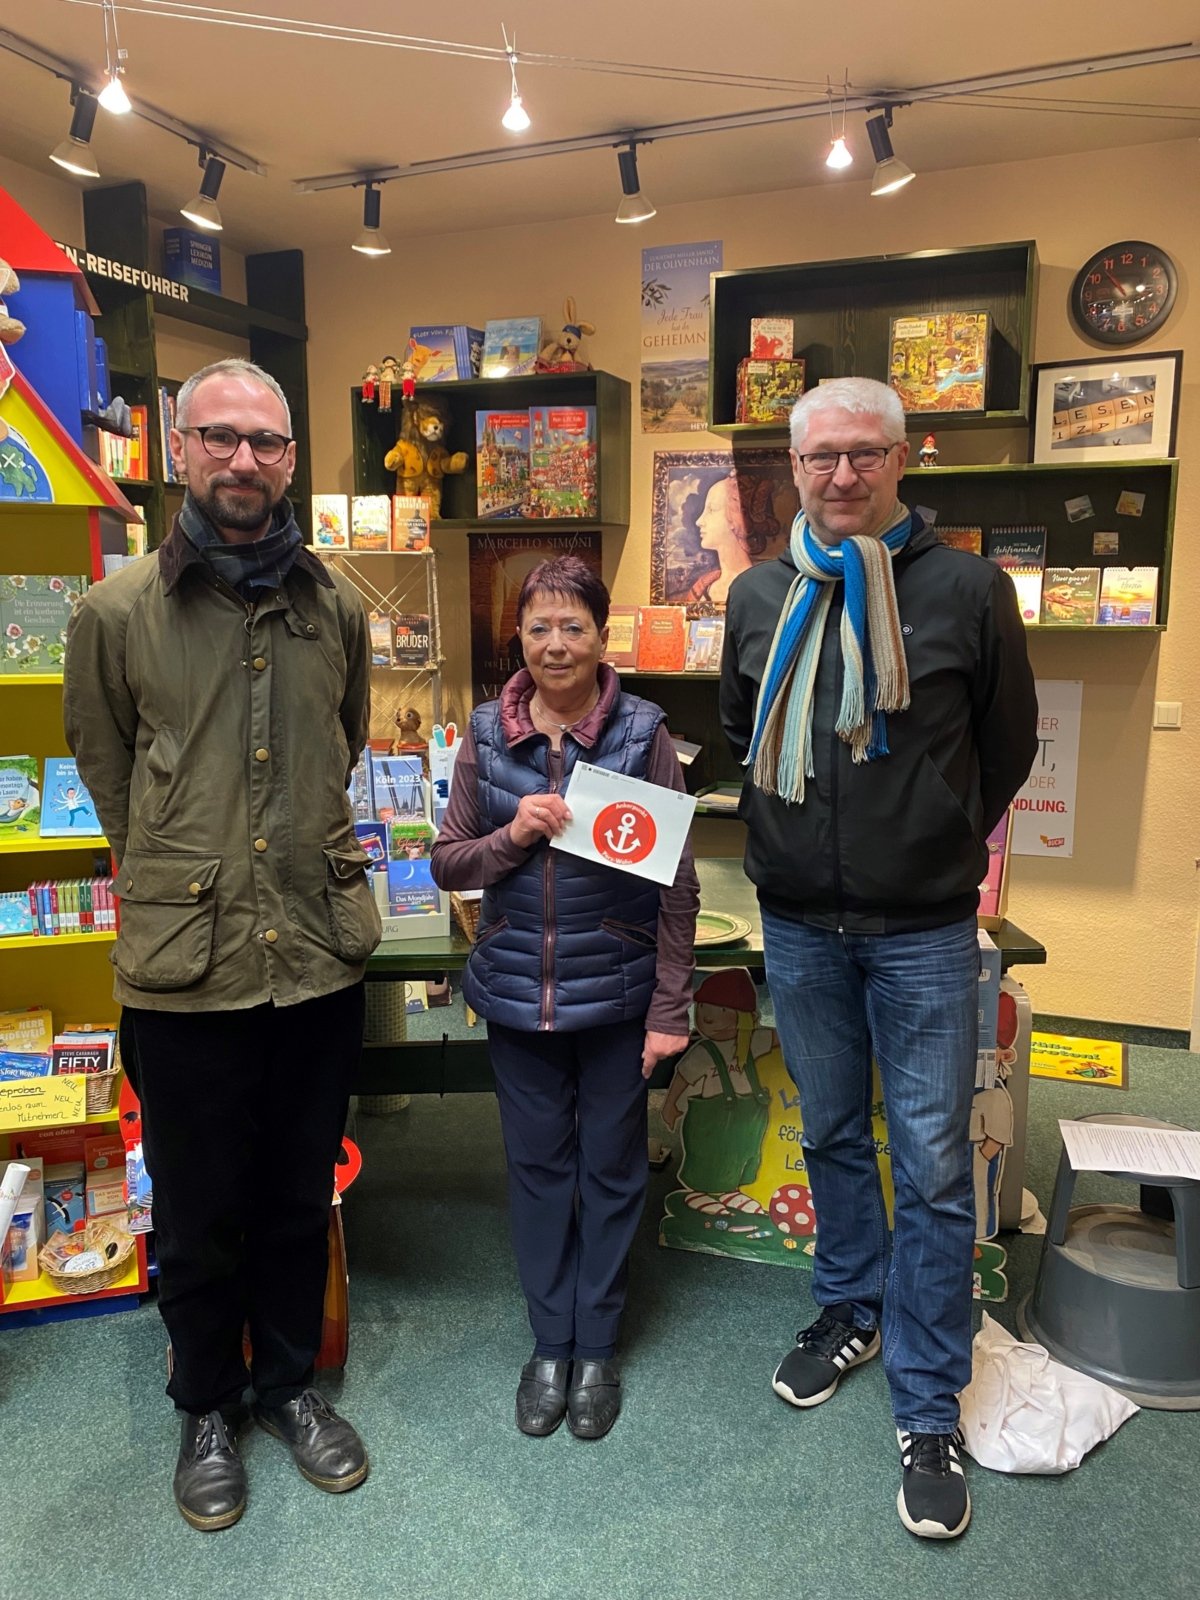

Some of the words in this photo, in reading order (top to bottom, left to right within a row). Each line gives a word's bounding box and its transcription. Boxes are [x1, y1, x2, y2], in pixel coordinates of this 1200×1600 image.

[190, 240, 212, 252] SPRINGER
[190, 249, 213, 260] LEXIKON
[1120, 253, 1133, 264] 12
[190, 257, 213, 269] MEDIZIN
[644, 262, 661, 272] DER
[662, 255, 720, 270] OLIVENHAIN
[1103, 259, 1114, 270] 11
[1141, 256, 1147, 267] 1
[1089, 273, 1102, 285] 10
[1152, 267, 1161, 279] 2
[1155, 284, 1164, 295] 3
[1149, 303, 1157, 313] 4
[657, 307, 678, 326] Jede
[681, 306, 704, 321] Frau
[1135, 314, 1145, 326] 5
[1117, 320, 1126, 332] 6
[643, 330, 707, 348] GEHEIMN
[478, 537, 541, 549] MARCELLO
[547, 536, 592, 549] SIMONI
[993, 543, 1042, 556] Achtsamkeit
[1052, 573, 1067, 583] Never
[1067, 573, 1079, 584] give
[25, 600, 64, 608] Erinnerung
[24, 615, 56, 624] Geschenk
[375, 774, 397, 784] Köln
[398, 774, 421, 784] 2023
[1029, 775, 1056, 789] DER
[615, 802, 648, 818] Ankerpunkt
[395, 895, 407, 903] Das
[407, 894, 434, 904] Mondjahr
[59, 1056, 101, 1067] FIFTY
[62, 1077, 78, 1092] NEU
[54, 1095, 73, 1104] NEU
[72, 1097, 84, 1118] NEU
[18, 1111, 69, 1123] Mitnehmen
[55, 1128, 75, 1136] oben
